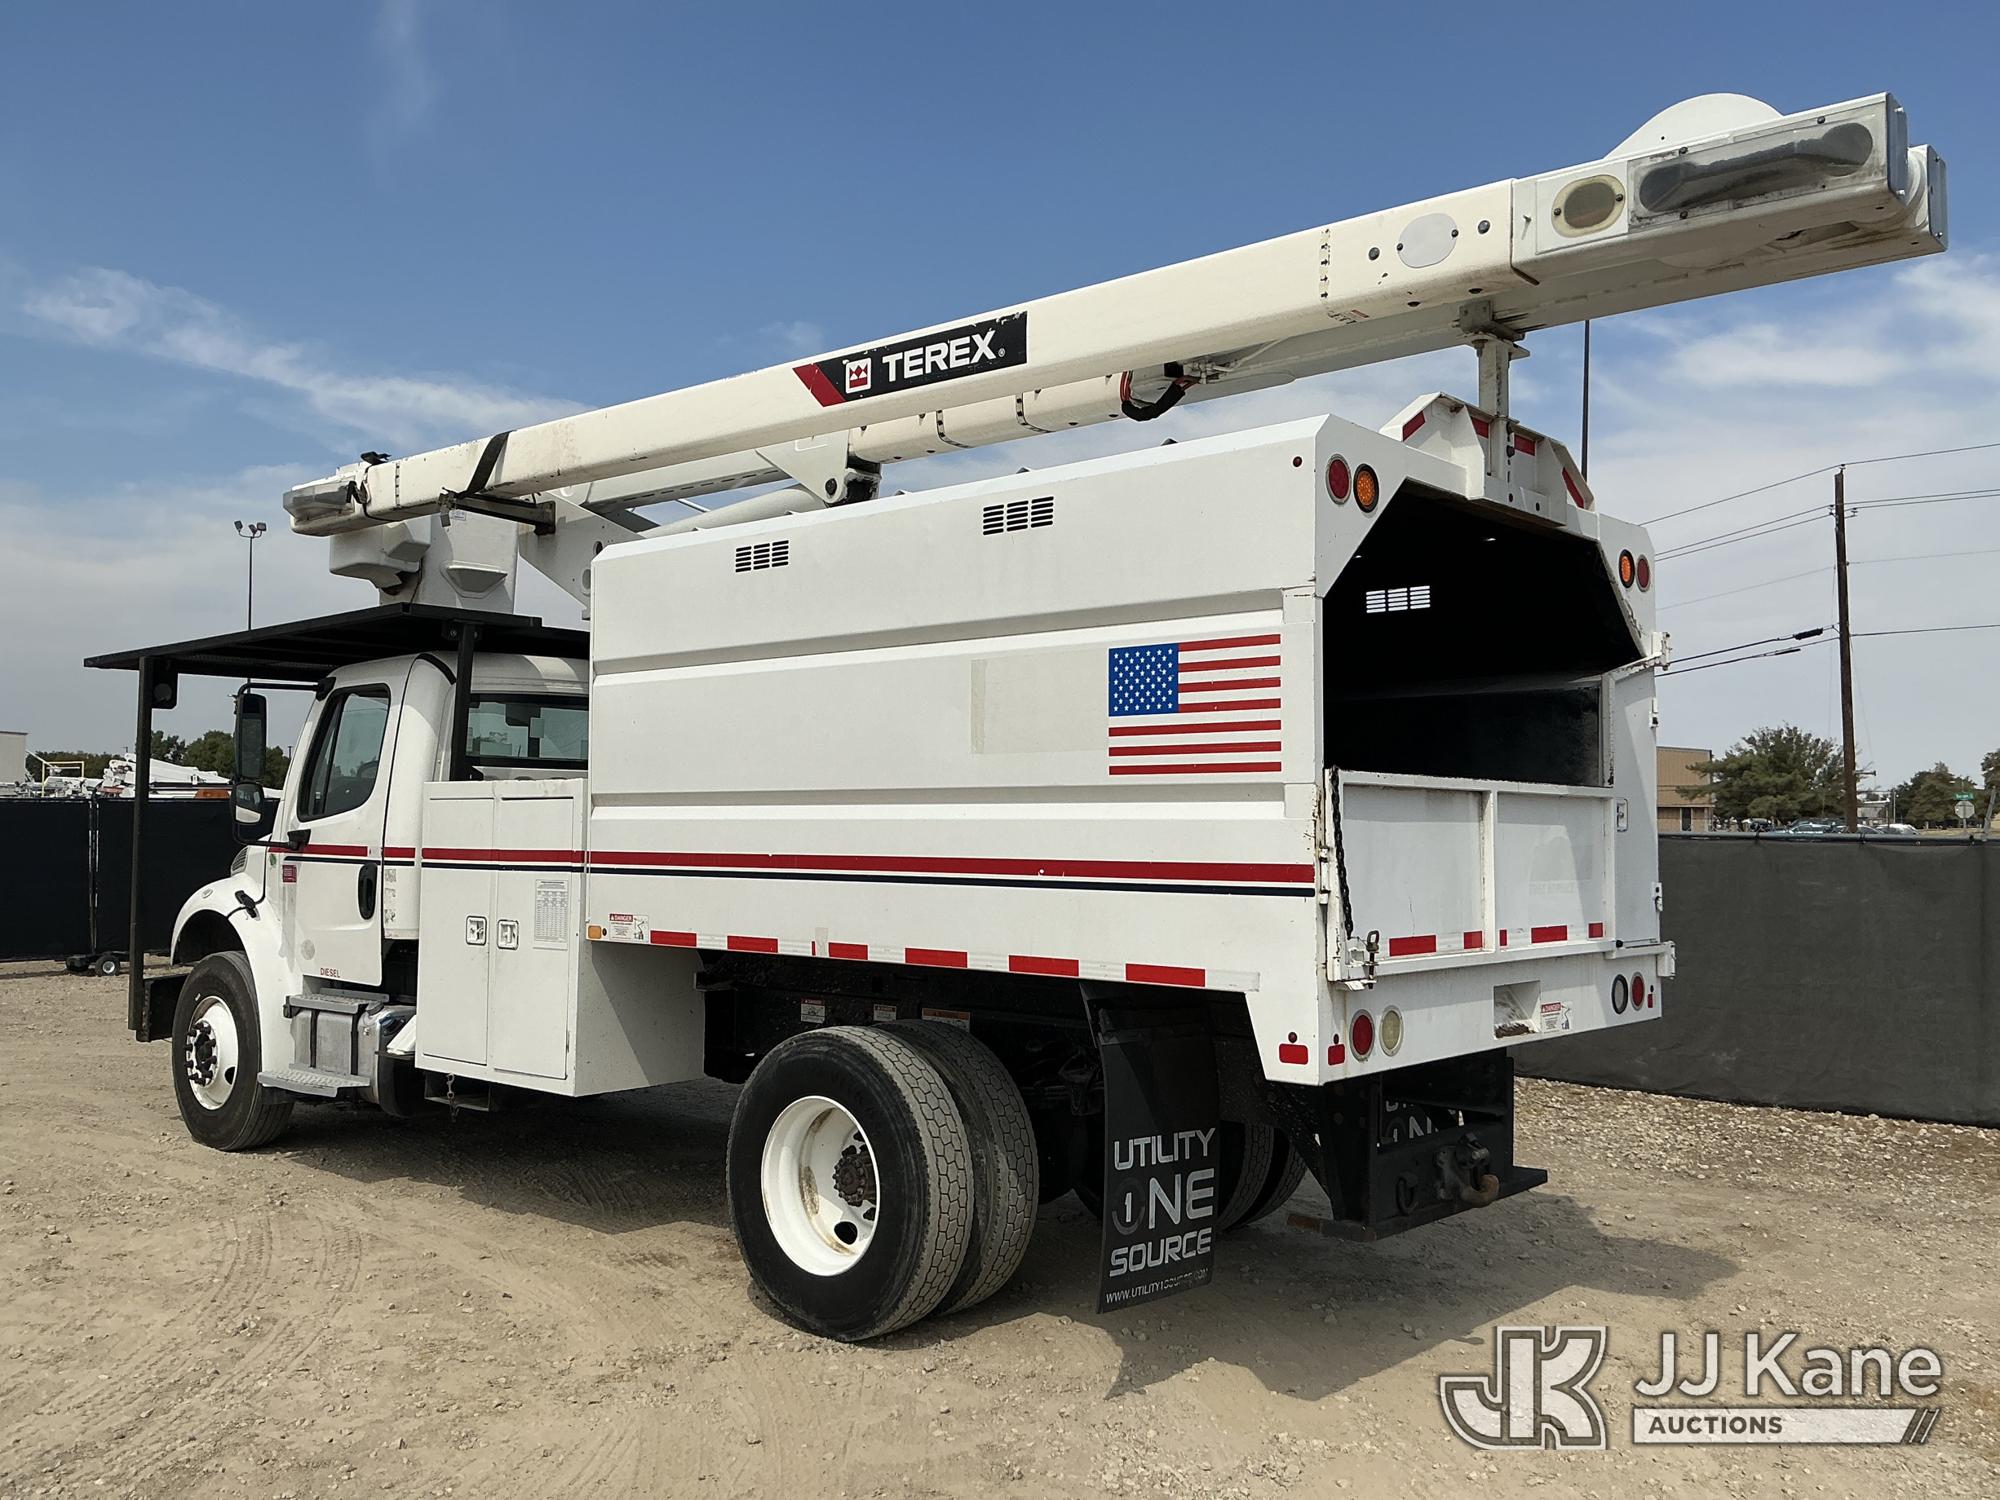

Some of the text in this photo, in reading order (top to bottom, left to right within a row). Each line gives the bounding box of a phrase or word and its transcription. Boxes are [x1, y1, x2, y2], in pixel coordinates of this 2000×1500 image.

[882, 330, 996, 382] TEREX
[320, 967, 341, 978] DIESEL
[1114, 1128, 1216, 1171] UTILITY
[1109, 1227, 1213, 1277] SOURCE
